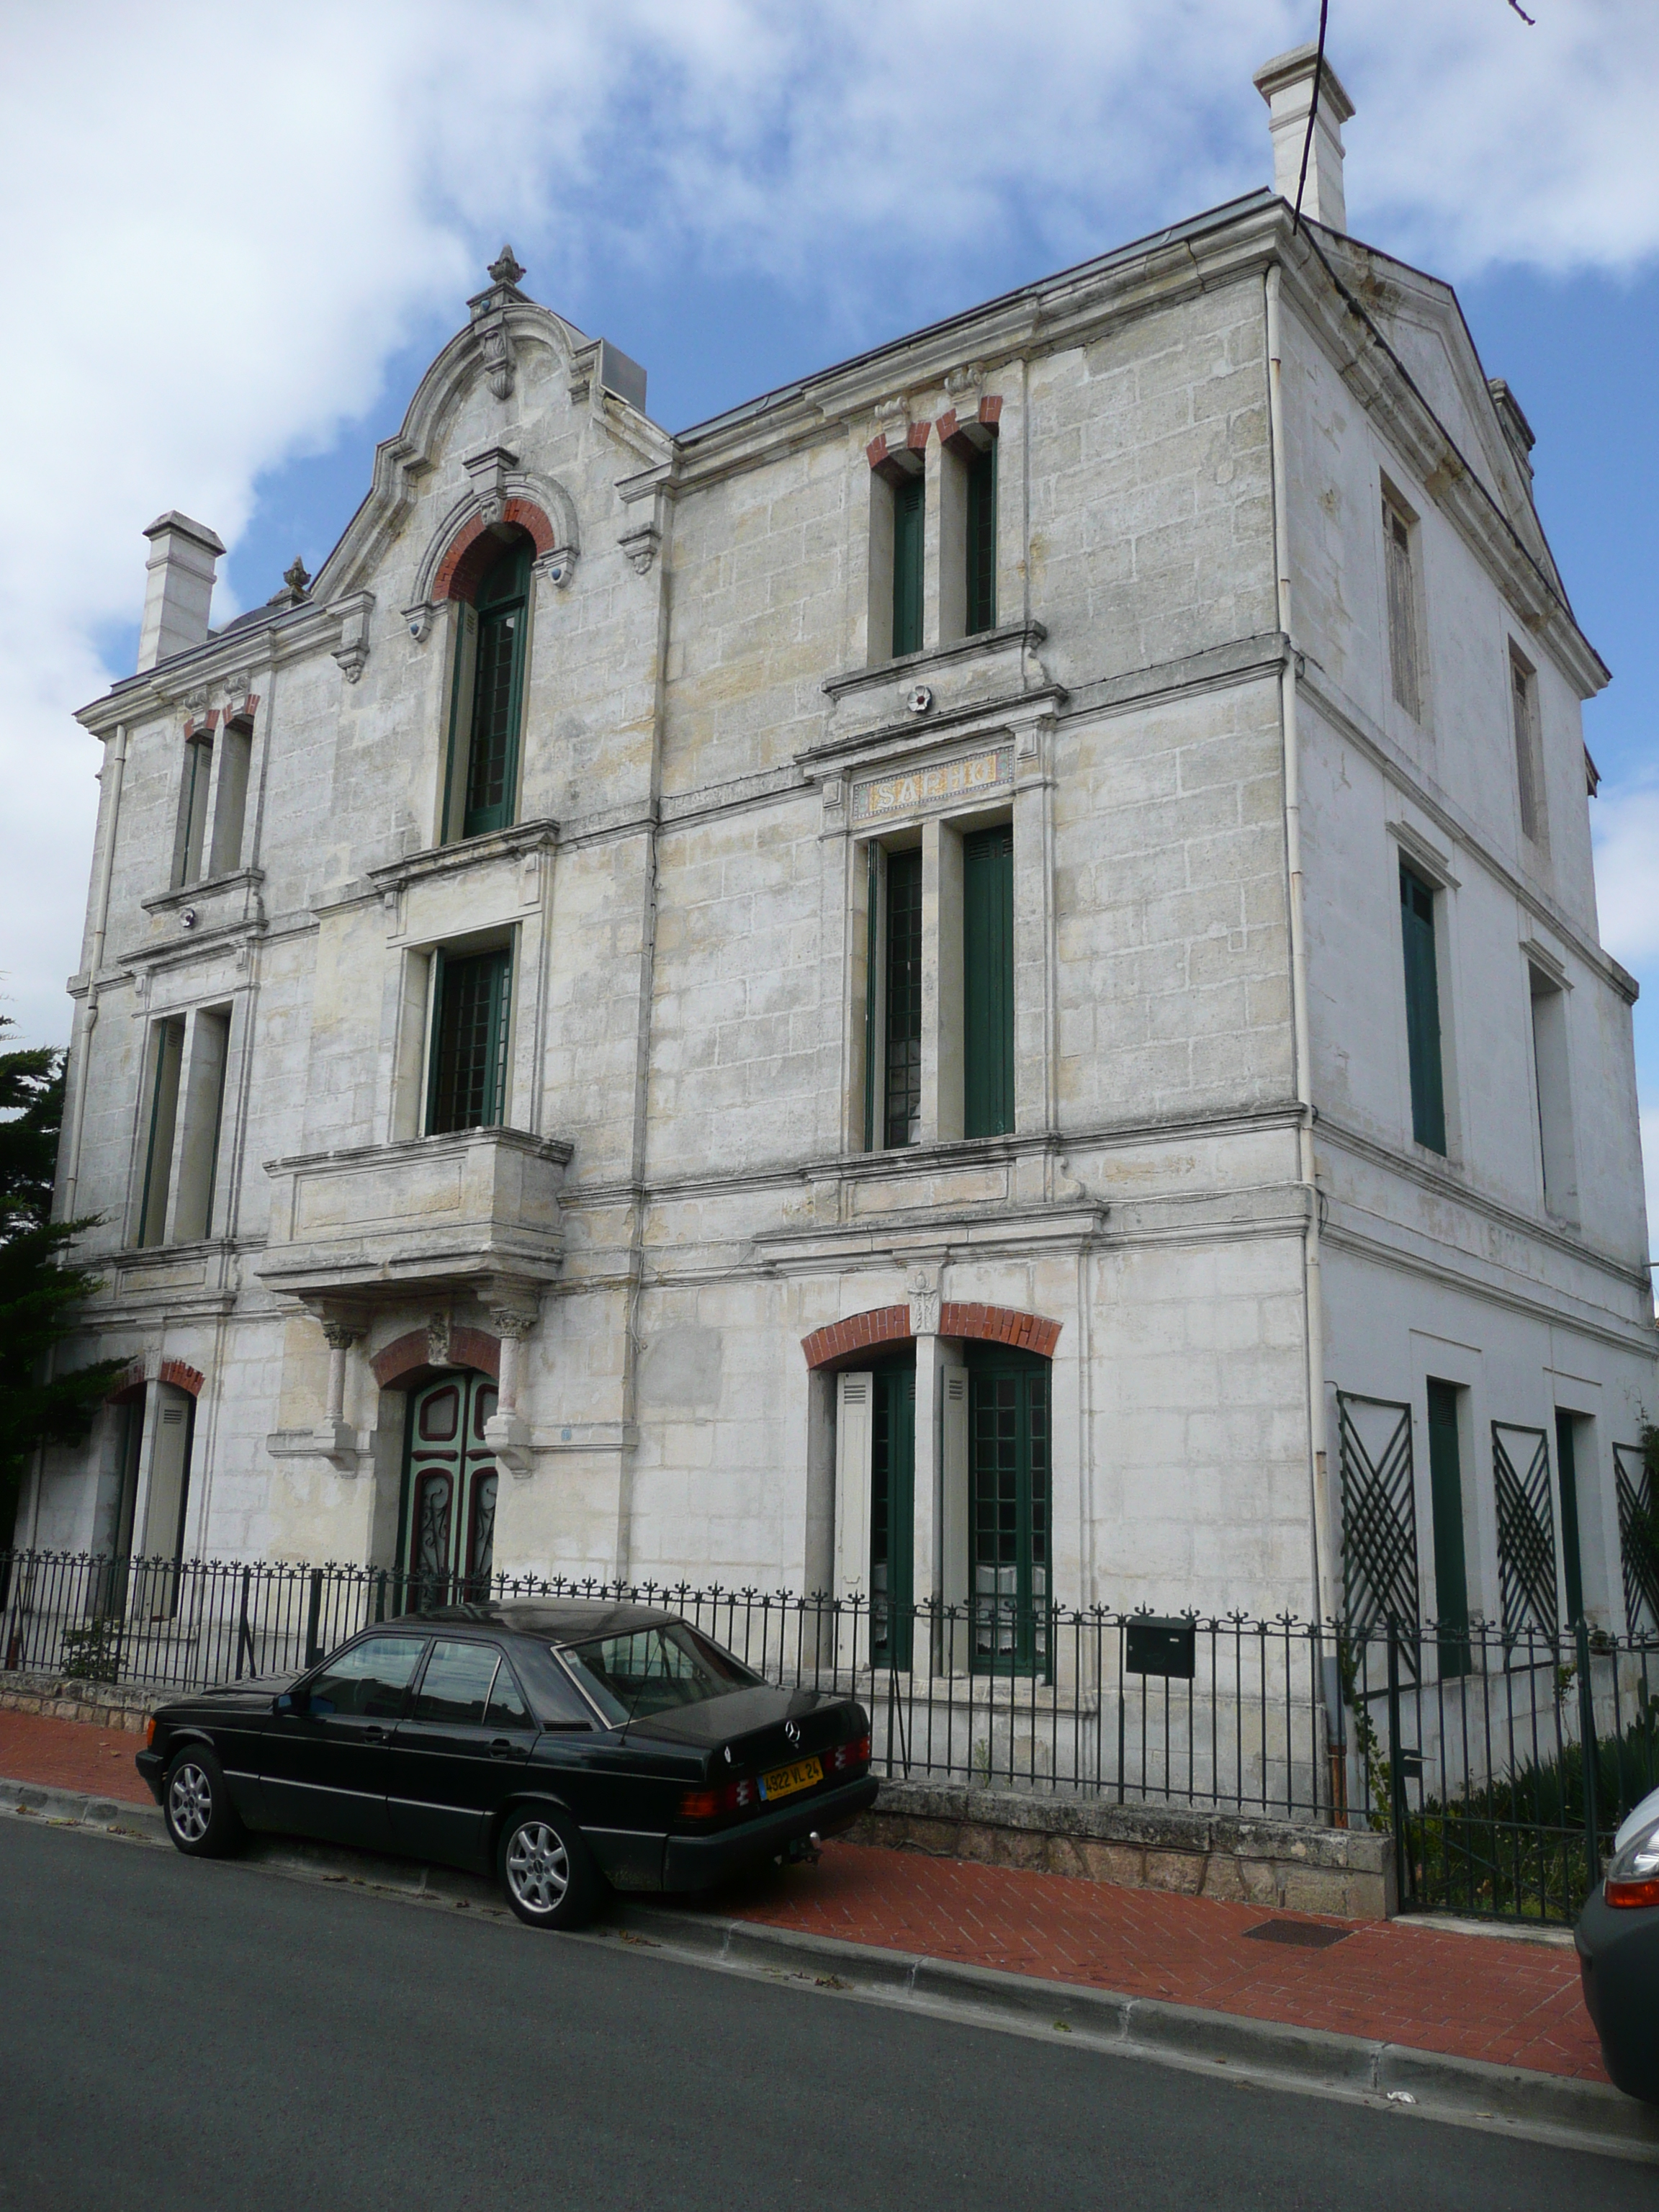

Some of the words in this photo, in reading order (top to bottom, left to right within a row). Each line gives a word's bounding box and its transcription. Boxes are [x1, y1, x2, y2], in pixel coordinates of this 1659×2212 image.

[878, 760, 989, 808] SAPHO
[765, 1772, 791, 1792] 4922
[791, 1767, 806, 1784] VL
[806, 1760, 819, 1779] 24
